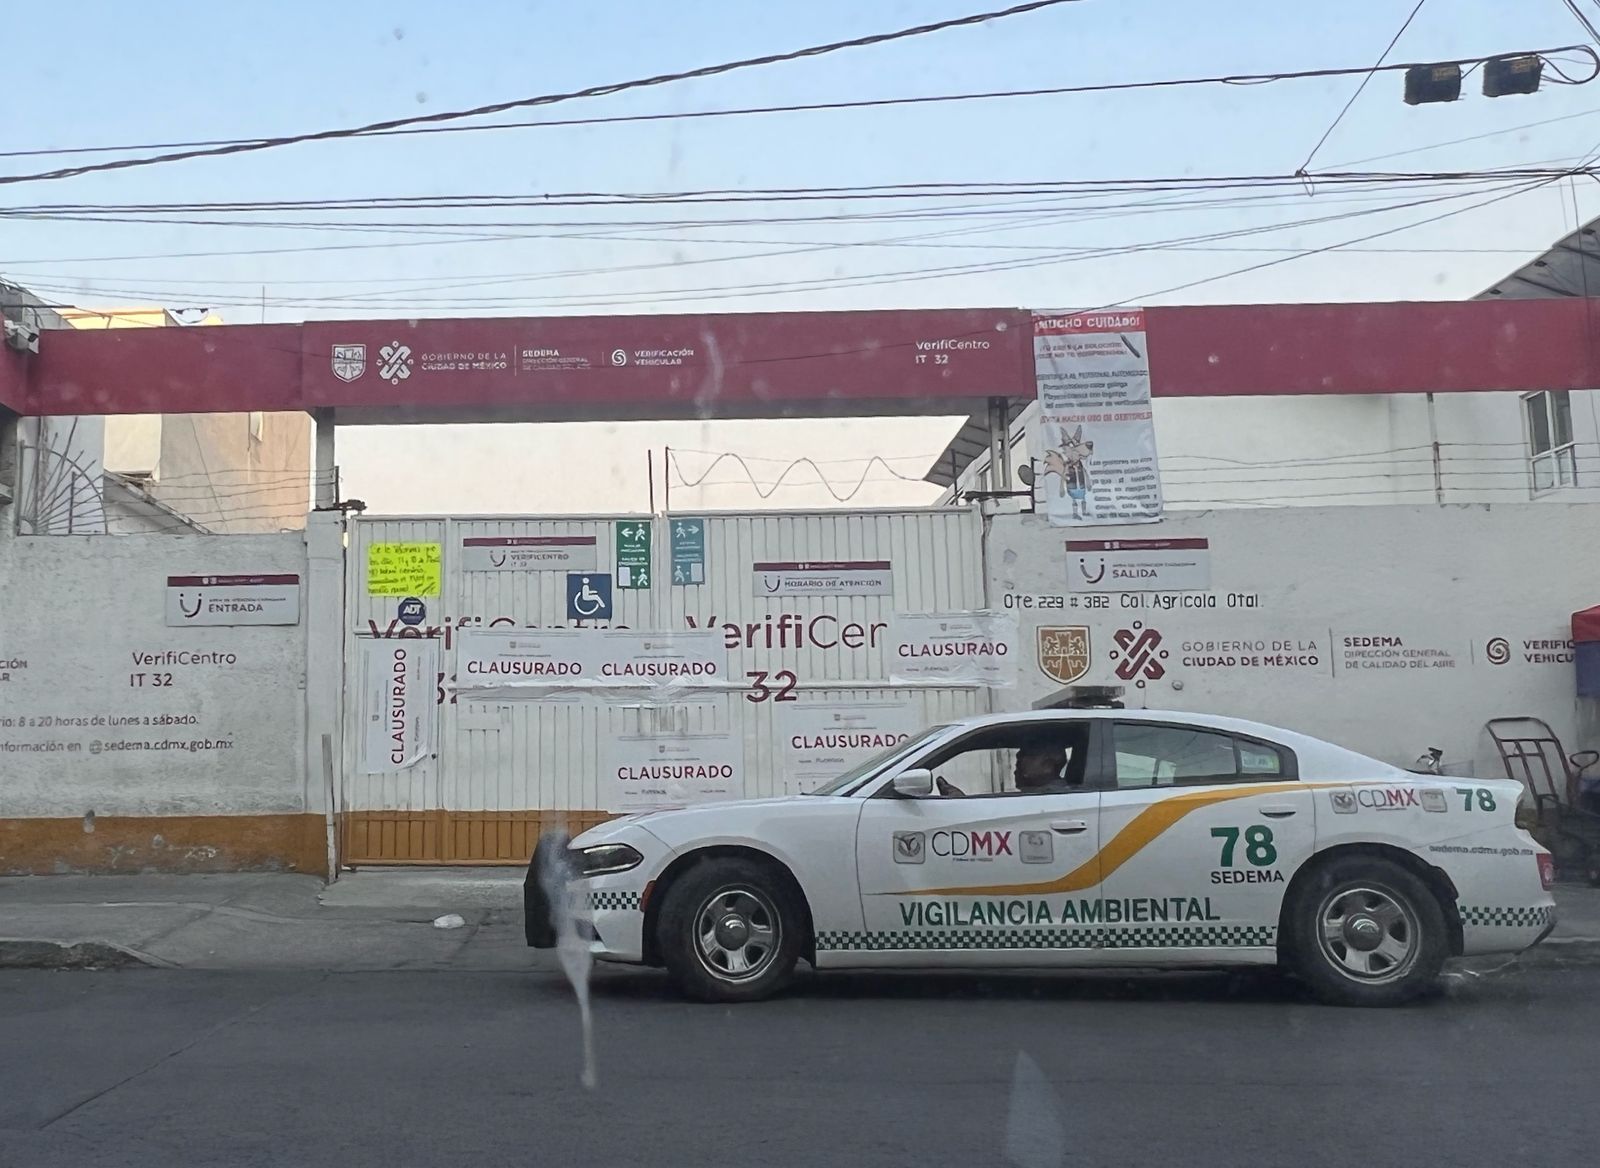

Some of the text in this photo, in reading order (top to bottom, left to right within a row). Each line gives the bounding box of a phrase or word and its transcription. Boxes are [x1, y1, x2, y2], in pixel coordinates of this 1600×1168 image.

[916, 339, 990, 350] VerifiCentro
[421, 352, 506, 361] GOBIERNO DE LA
[915, 354, 949, 364] IT 32
[421, 362, 456, 370] CIUDAD
[457, 362, 470, 370] DE
[1112, 569, 1158, 578] SALIDA
[208, 603, 264, 613] ENTRADA
[403, 604, 421, 615] ADT
[1181, 640, 1317, 652] GOBIERNO DE LA
[1344, 637, 1403, 647] SEDEMA
[132, 651, 237, 665] VerifiCentro
[1182, 653, 1319, 667] CIUDAD DE MÉXICO
[1345, 649, 1451, 658] DIRECCIÓN GENERAL
[467, 661, 582, 675] CLAUSURADO
[602, 662, 717, 676] CLAUSURADO
[1345, 660, 1359, 669] DE
[1362, 660, 1407, 669] CALIDAD
[1410, 660, 1429, 669] DEL
[130, 672, 173, 687] IT 32
[746, 670, 797, 702] 32
[391, 648, 407, 764] CLAUSURADO
[18, 716, 26, 727] 8
[29, 718, 36, 727] a
[38, 716, 53, 727] 20
[56, 715, 89, 727] horas
[91, 715, 106, 726] de
[108, 715, 140, 726] lunes
[143, 717, 150, 726] a
[152, 714, 199, 726] sábado.
[67, 742, 82, 751] en
[618, 765, 733, 780] CLAUSURADO
[1357, 788, 1497, 812] CDMX 78
[932, 831, 1013, 856] CDMX
[1210, 825, 1278, 868] 78
[1210, 870, 1285, 884] SEDEMA
[900, 897, 1221, 926] VIGILANCIA AMBIENTAL
